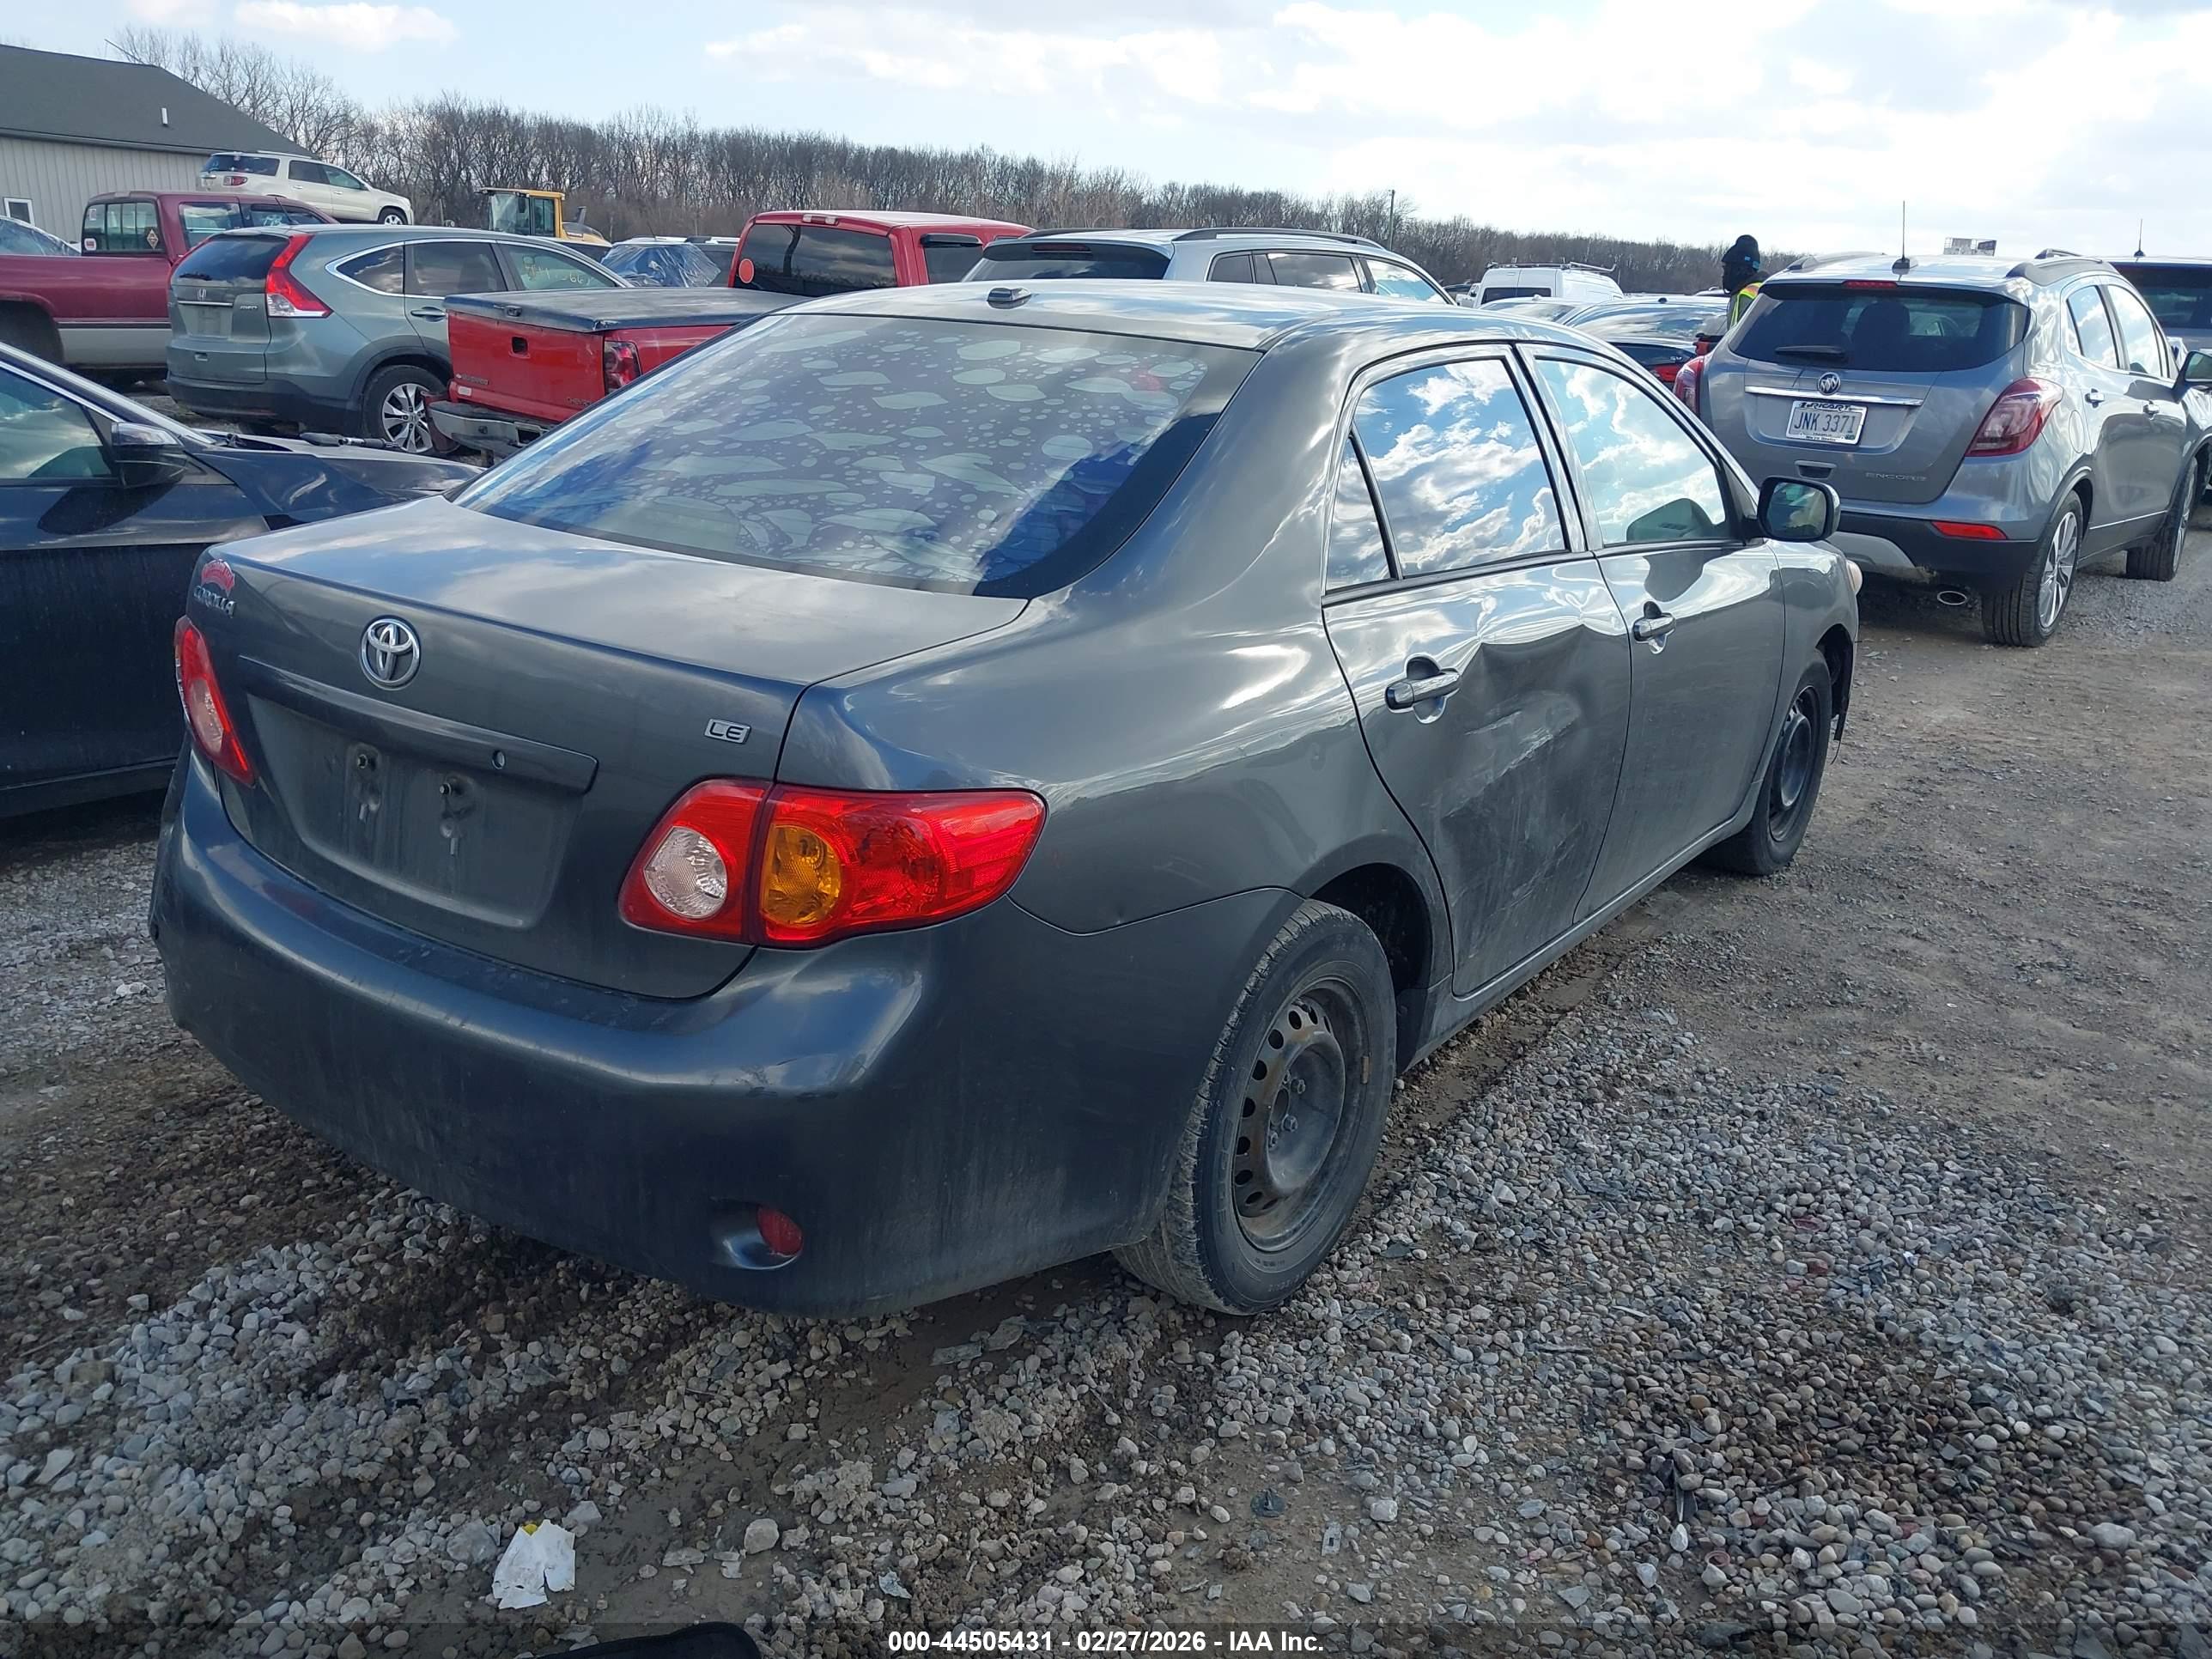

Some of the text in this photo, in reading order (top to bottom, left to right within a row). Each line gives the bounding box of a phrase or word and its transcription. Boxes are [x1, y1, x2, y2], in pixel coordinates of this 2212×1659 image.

[1794, 411, 1856, 434] JNK 3371
[708, 720, 745, 741] LE
